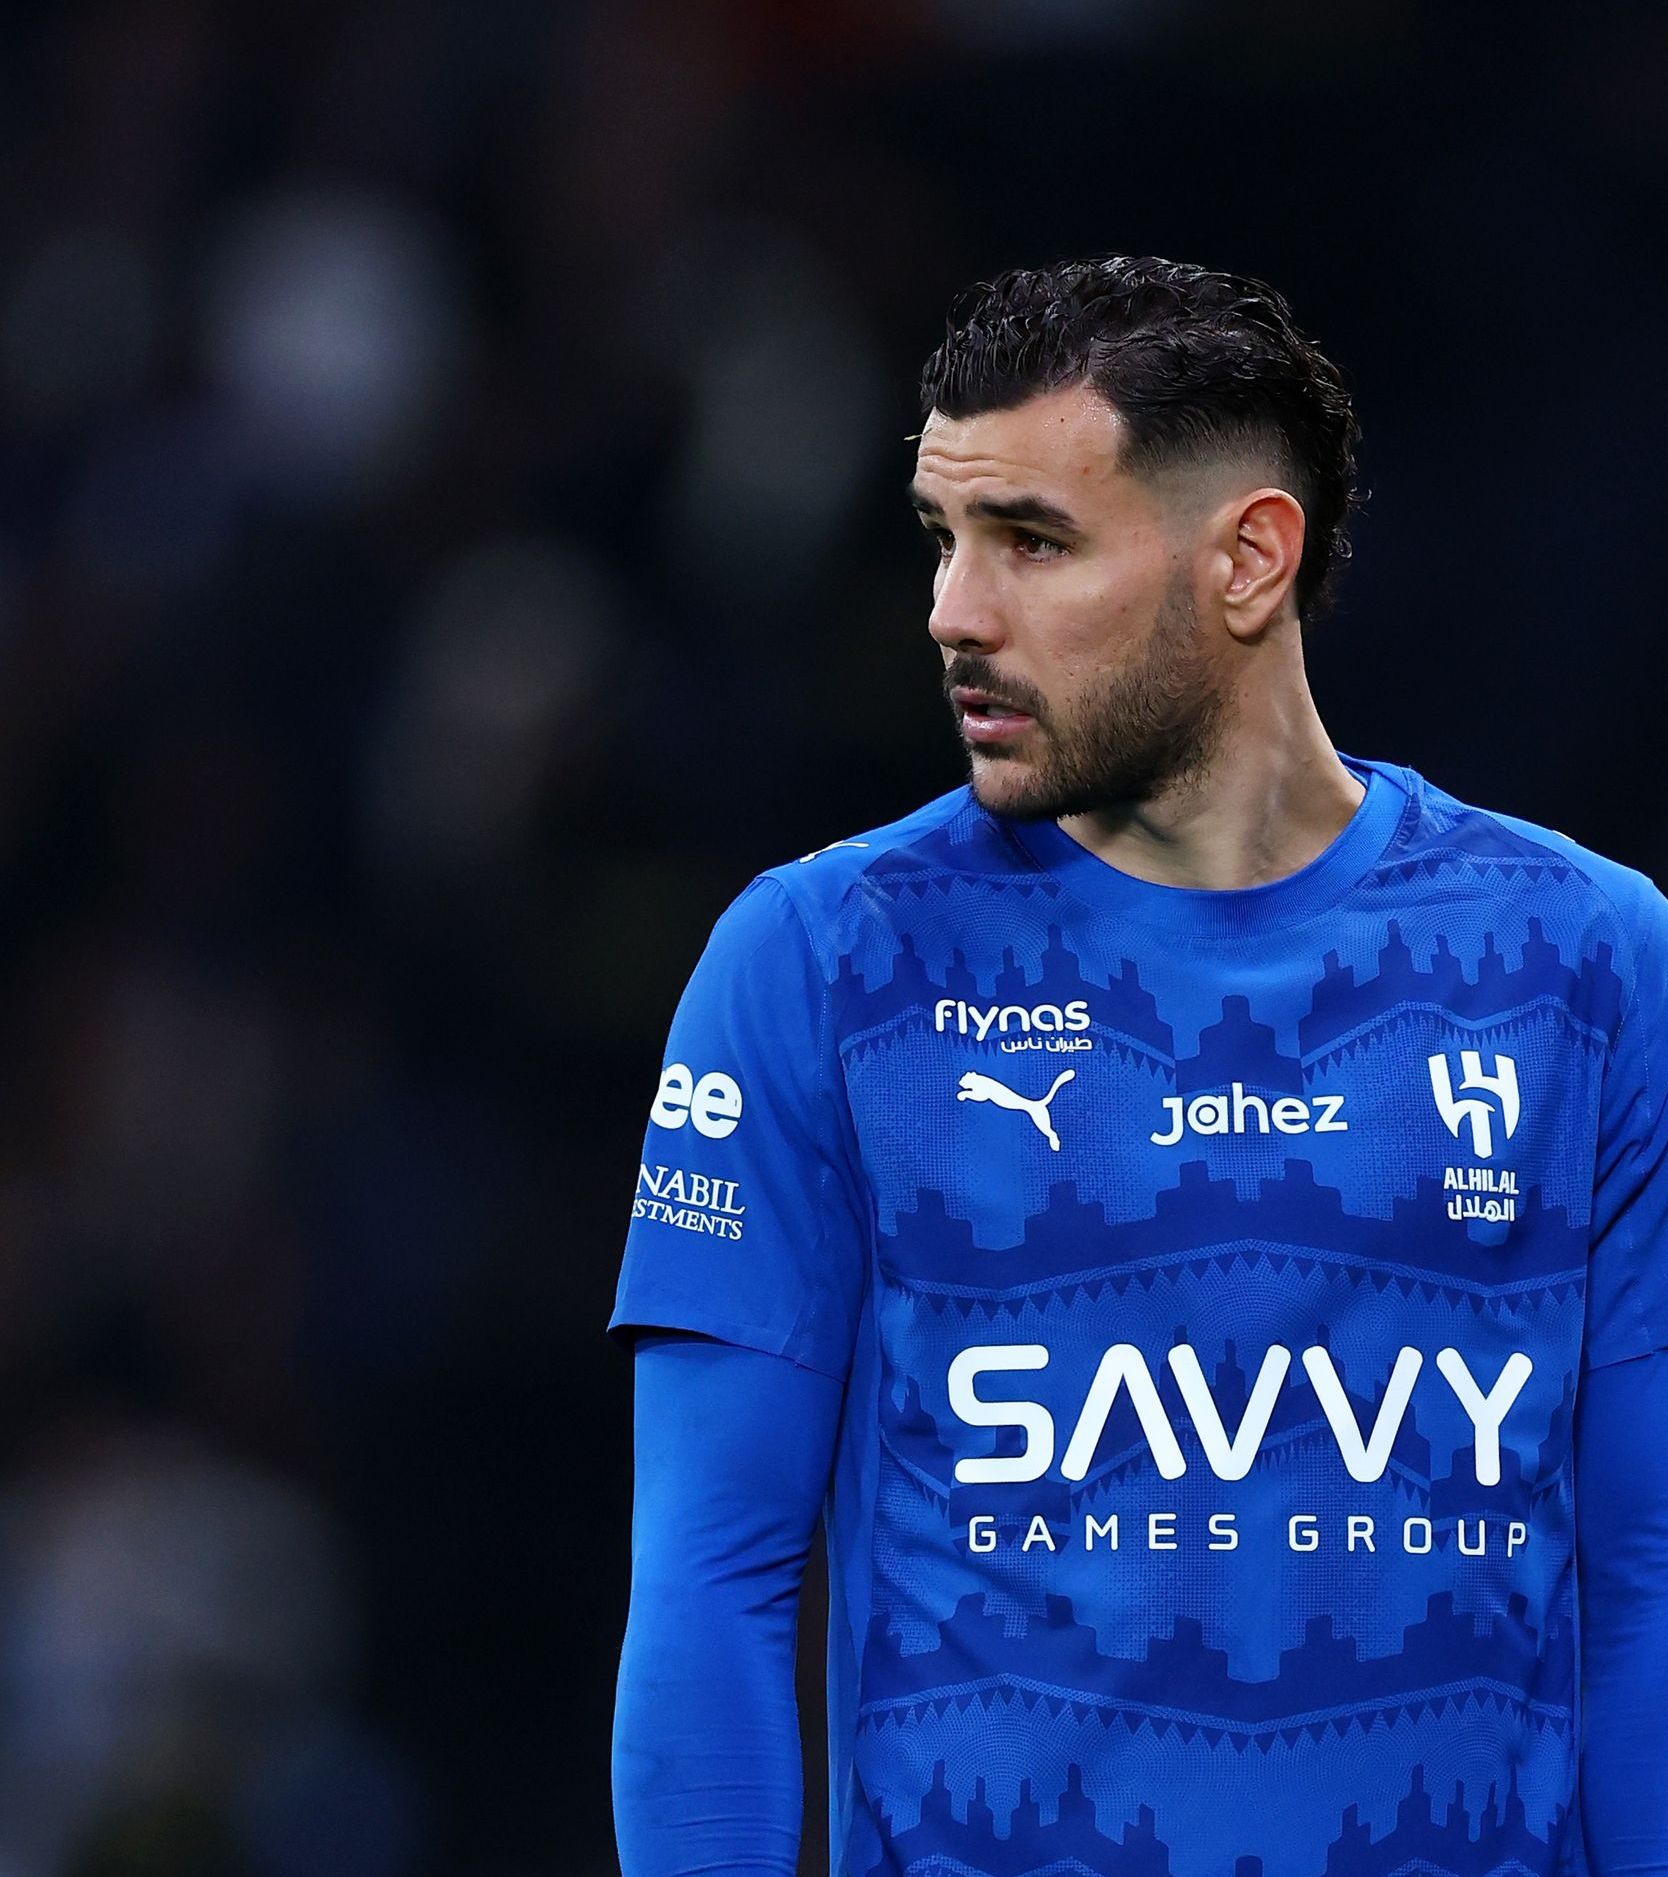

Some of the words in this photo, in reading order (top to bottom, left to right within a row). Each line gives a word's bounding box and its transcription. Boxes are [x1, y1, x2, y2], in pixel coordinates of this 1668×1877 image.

[934, 999, 1091, 1042] flynas
[1000, 1036, 1043, 1054] ناس
[1045, 1036, 1093, 1054] طيران
[635, 1163, 746, 1215] NABIL
[632, 1198, 744, 1241] STMENTS
[946, 1342, 1534, 1487] SAVVY
[967, 1513, 1240, 1553] GAMES
[1287, 1514, 1528, 1559] GROUP
